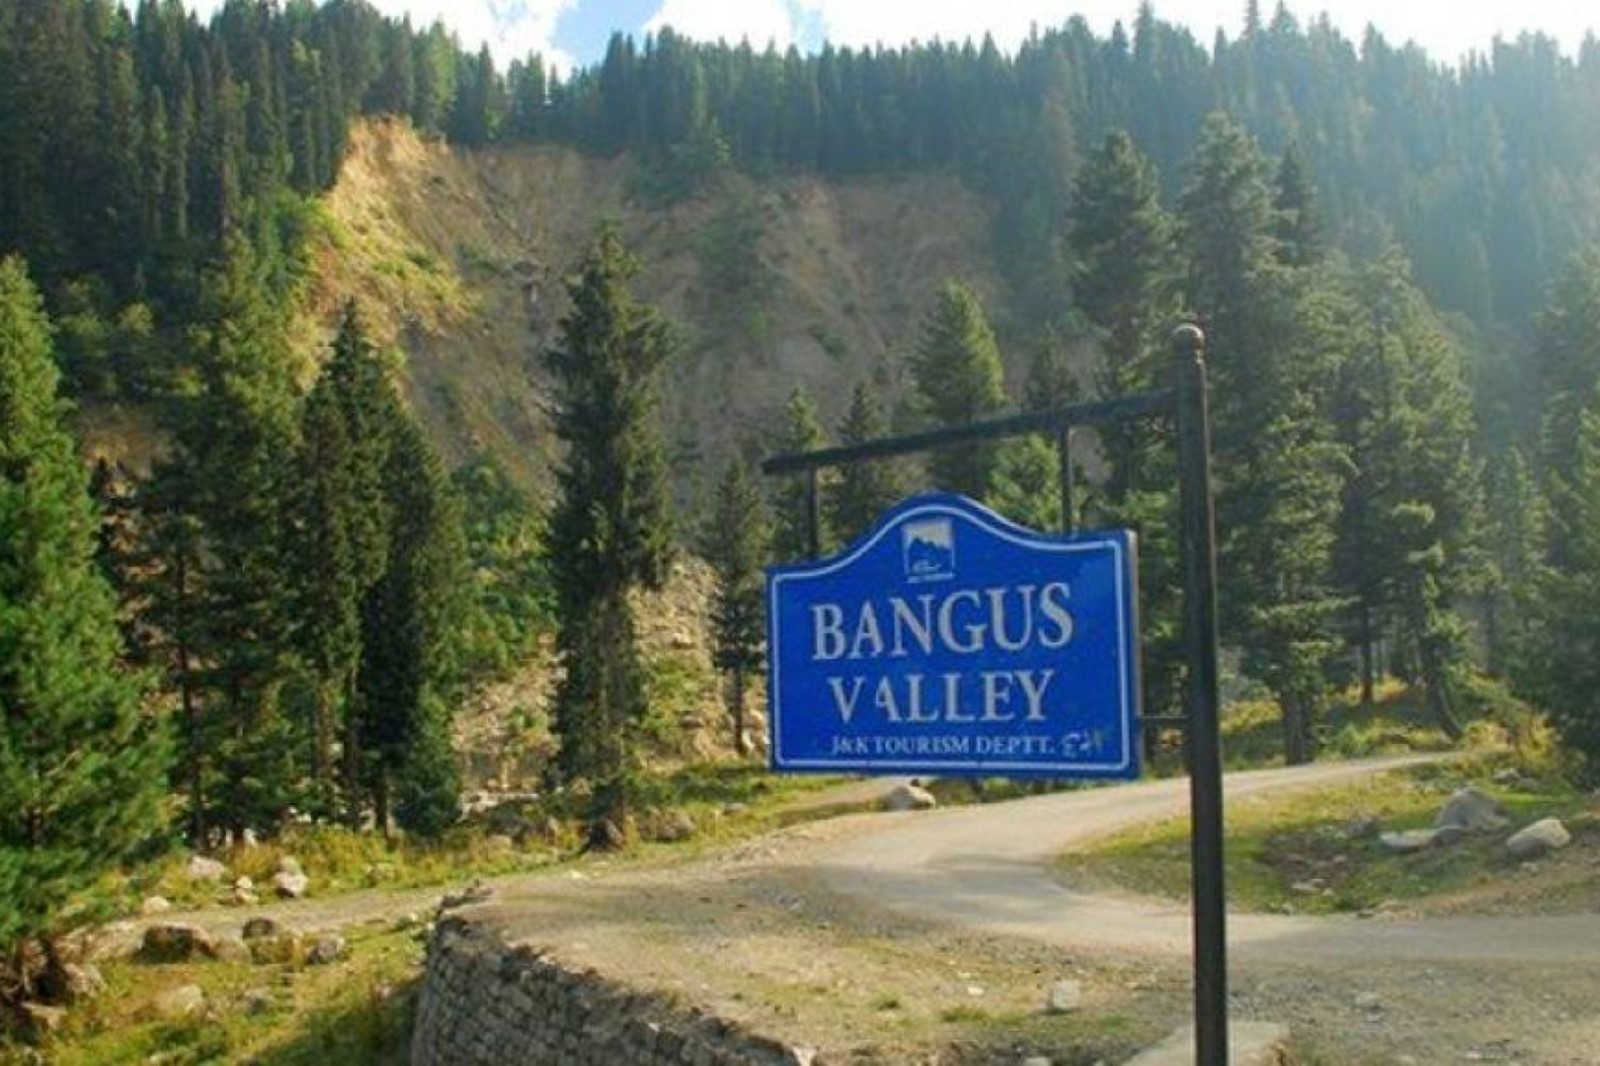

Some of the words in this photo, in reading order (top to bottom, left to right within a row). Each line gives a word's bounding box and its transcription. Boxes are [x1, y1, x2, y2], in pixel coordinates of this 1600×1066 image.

[810, 582, 1074, 660] BANGUS
[827, 668, 1054, 724] VALLEY
[873, 735, 970, 755] TOURISM
